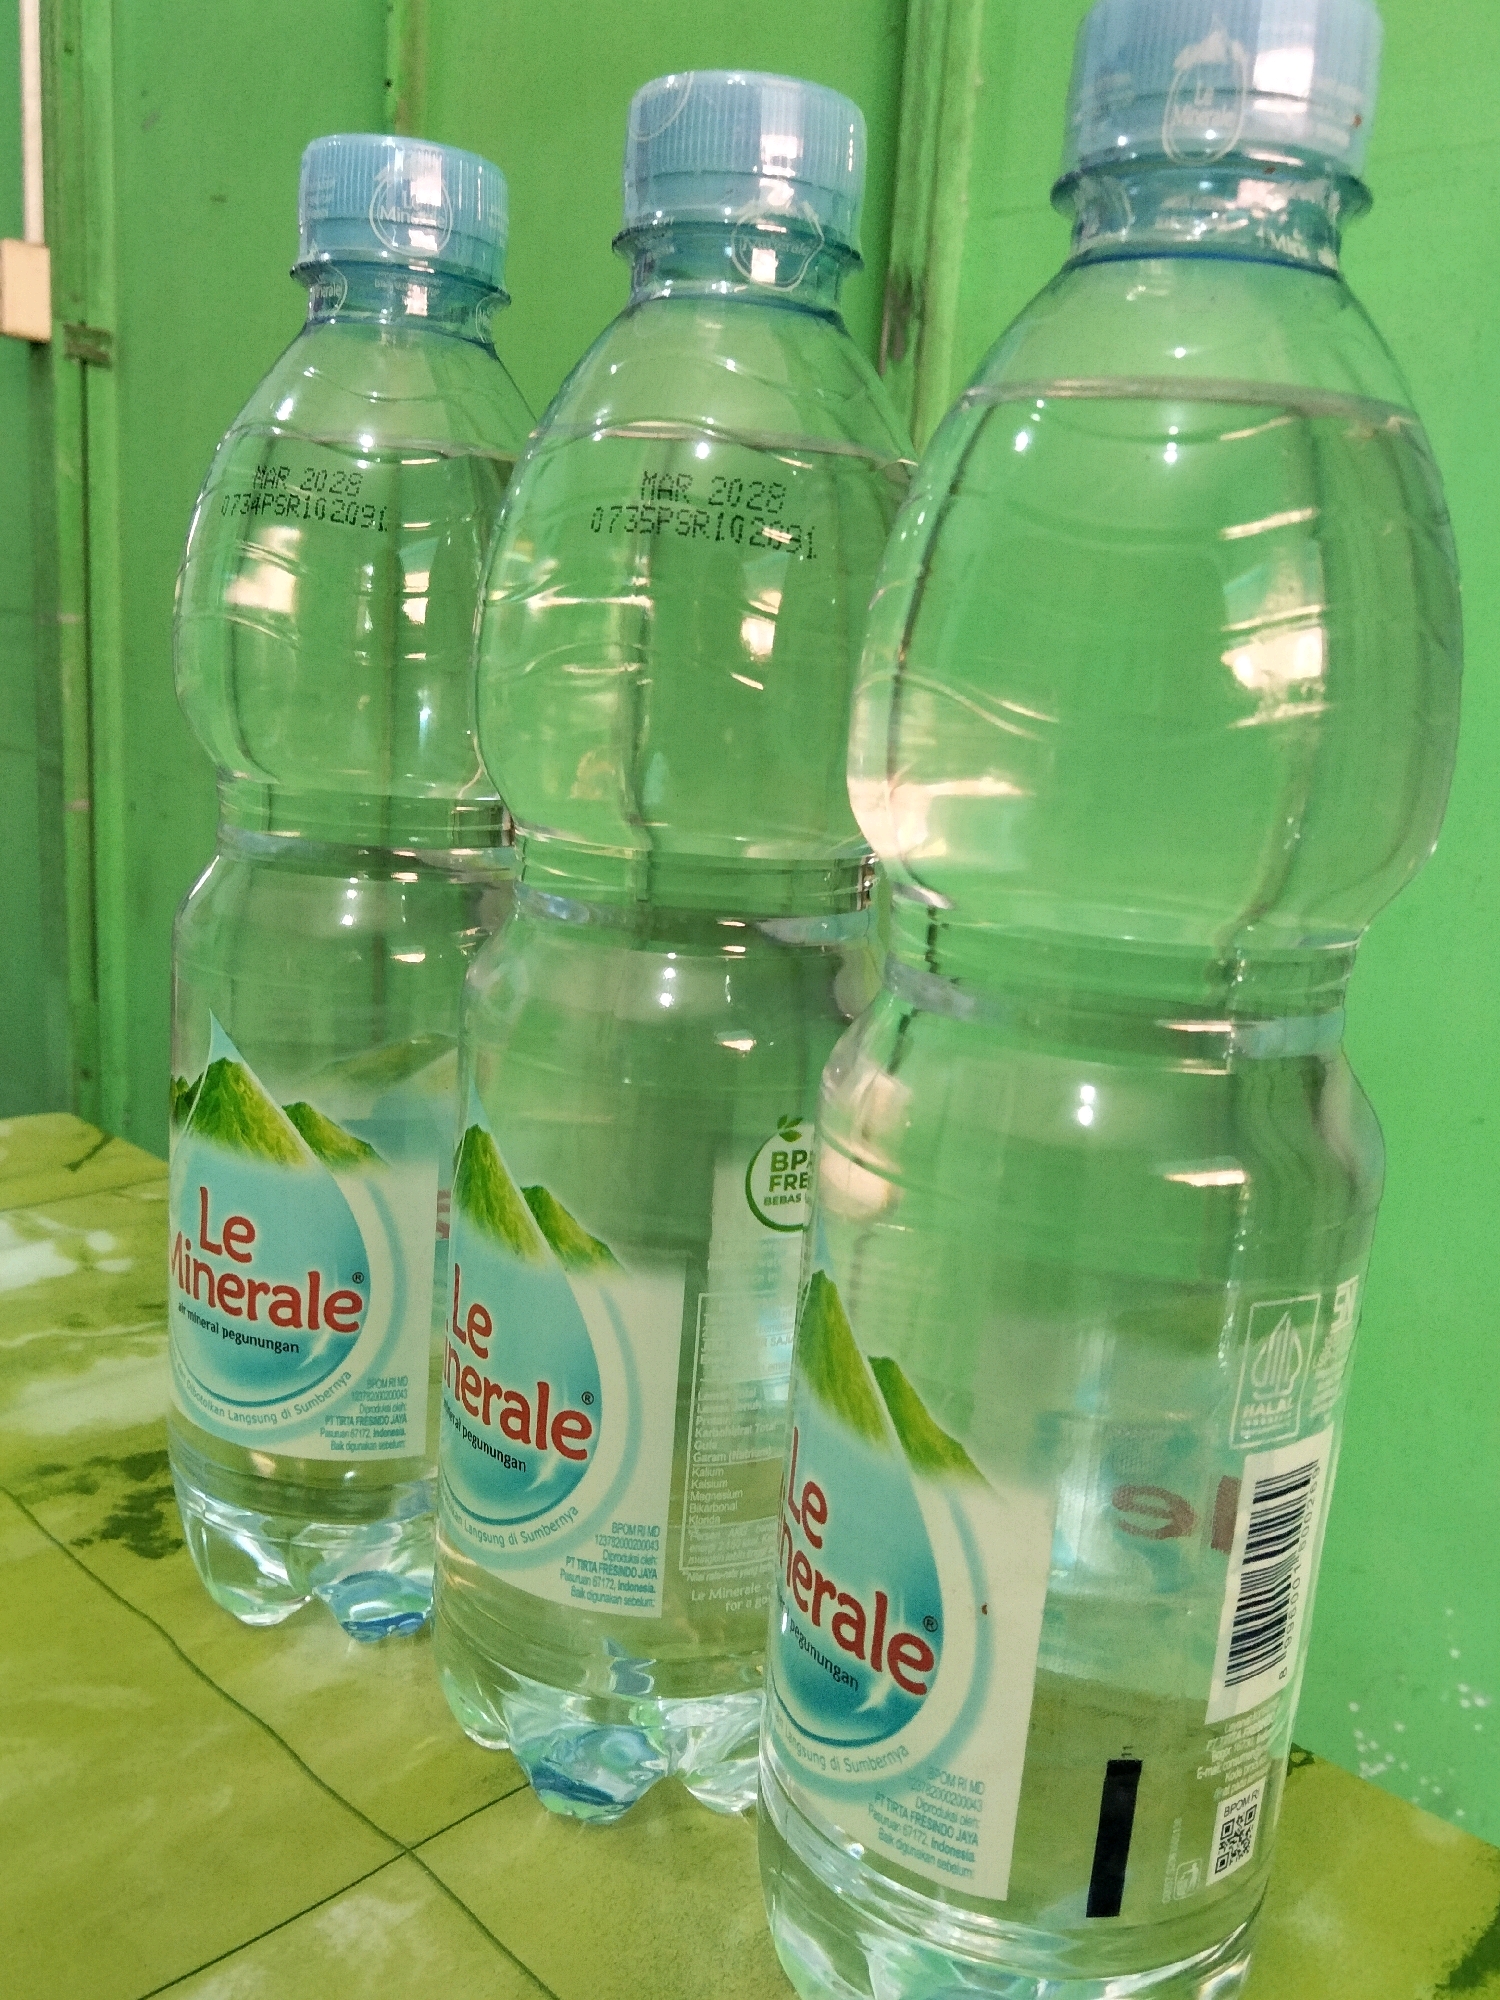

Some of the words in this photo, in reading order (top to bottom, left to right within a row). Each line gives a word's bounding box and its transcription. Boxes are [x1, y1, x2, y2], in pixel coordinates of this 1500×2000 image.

[253, 465, 291, 490] MAR
[299, 467, 364, 498] 2028
[640, 470, 693, 504] MAR
[708, 476, 786, 514] 2028
[220, 492, 388, 532] 0734PSR102091
[199, 1186, 256, 1263] Le
[170, 1231, 364, 1334] Minerale
[188, 1309, 220, 1334] mineral
[222, 1326, 300, 1354] pegunungan
[453, 1262, 493, 1360] Le
[227, 1411, 278, 1426] Langsung
[280, 1407, 292, 1420] di
[294, 1370, 352, 1416] Sumbernya
[443, 1318, 593, 1461] inerale
[462, 1425, 527, 1472] pegunungan
[692, 1467, 724, 1478] Kalium
[787, 1427, 828, 1549] Le
[464, 1519, 505, 1548] Langsung
[508, 1531, 519, 1546] di
[520, 1505, 579, 1544] Sumbernya
[565, 1555, 576, 1568] PT
[638, 1568, 658, 1580] JAYA
[1283, 1563, 1302, 1650] 996001
[1298, 1466, 1321, 1554] 600269
[708, 1581, 761, 1601] Minerale
[789, 1617, 860, 1692] pegunungan
[829, 1756, 841, 1773] di
[843, 1744, 910, 1773] Sumbernya
[1223, 1796, 1250, 1818] BPOM
[956, 1828, 979, 1847] JAYA
